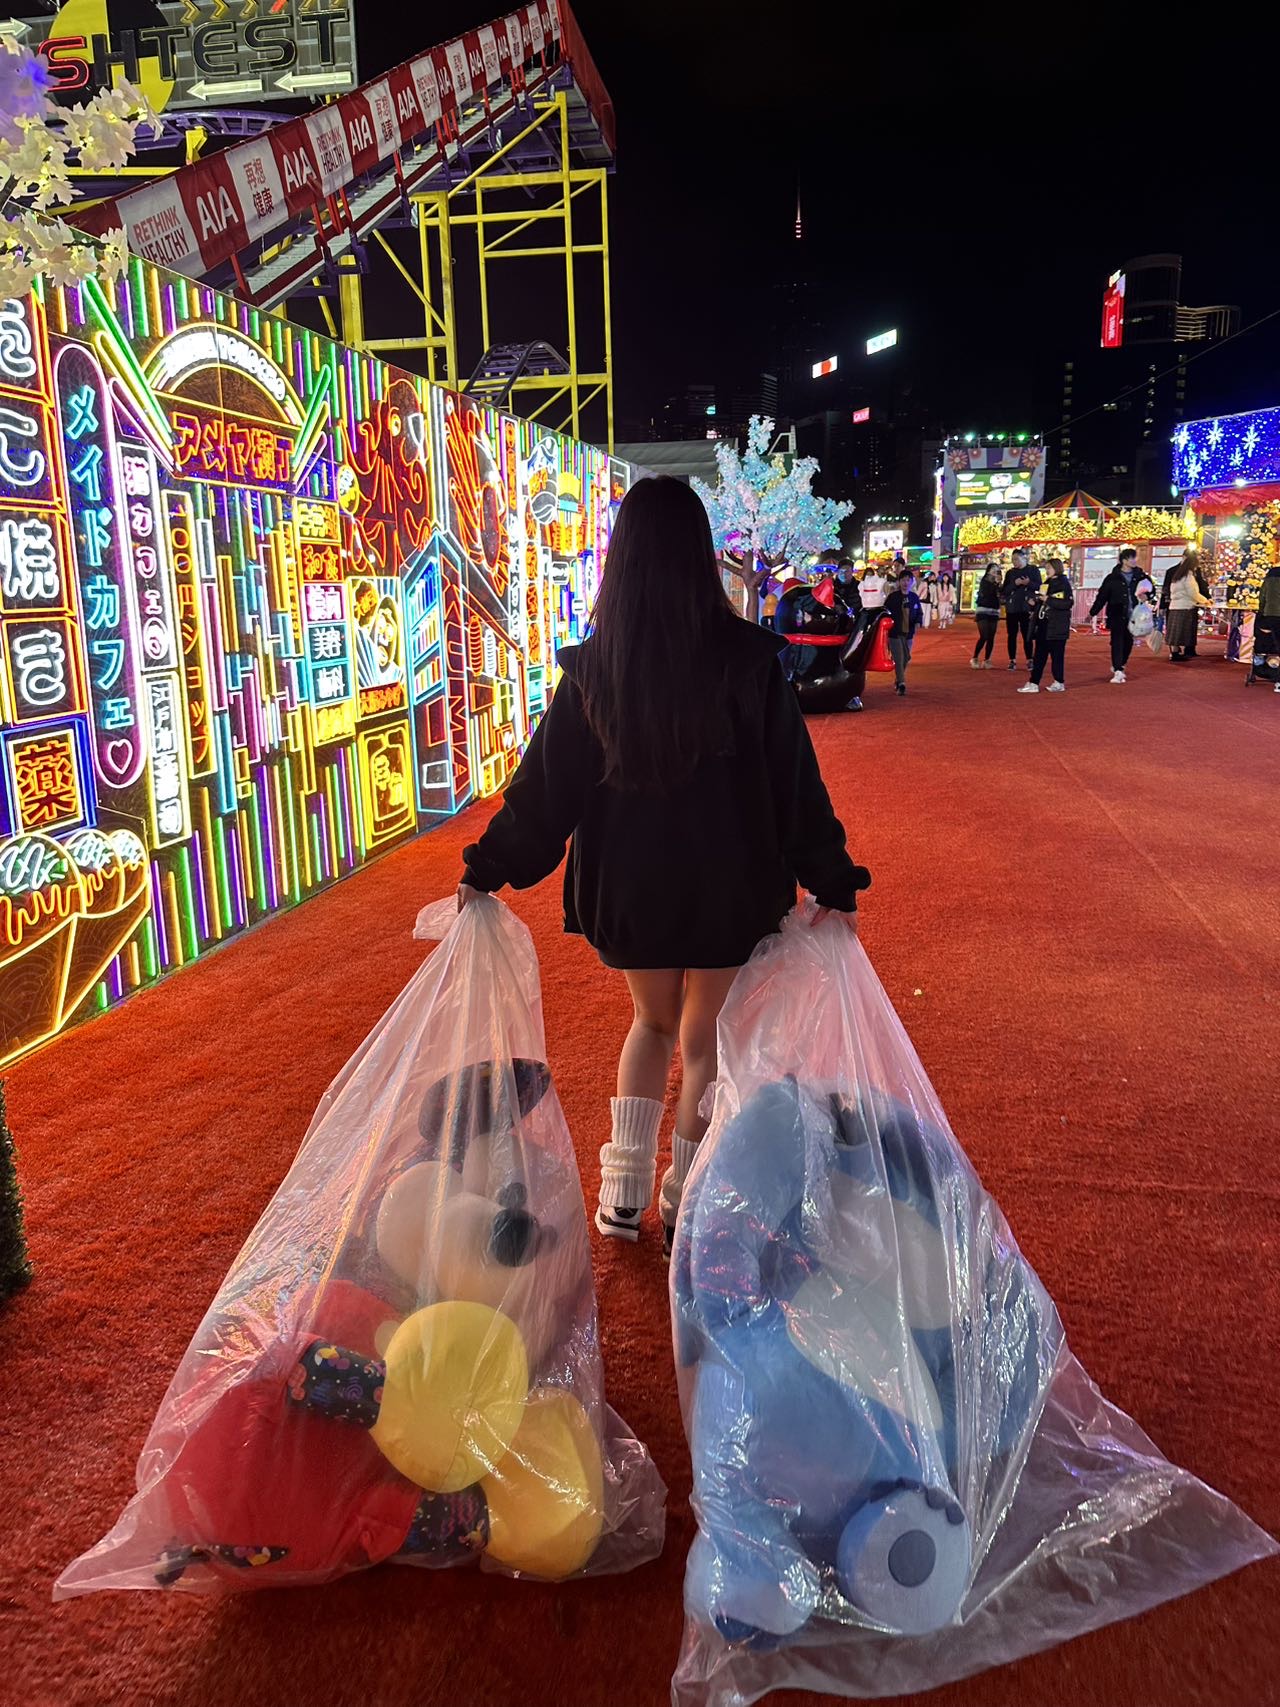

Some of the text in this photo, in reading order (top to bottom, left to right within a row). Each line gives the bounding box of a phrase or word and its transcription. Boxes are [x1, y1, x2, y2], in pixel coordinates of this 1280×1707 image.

[437, 66, 453, 98] AIA
[397, 86, 419, 124] AIA
[316, 126, 343, 153] RETHINK
[348, 114, 374, 156] AIA
[243, 157, 267, 190] 再想
[282, 146, 318, 193] AIA
[320, 142, 347, 175] HEALTHY
[195, 185, 239, 241] AIA
[252, 187, 275, 220] 健康
[132, 205, 181, 245] RETHINK
[140, 228, 190, 267] HEALTHY
[66, 384, 135, 730] メイドカフェ
[313, 626, 342, 659] 美容
